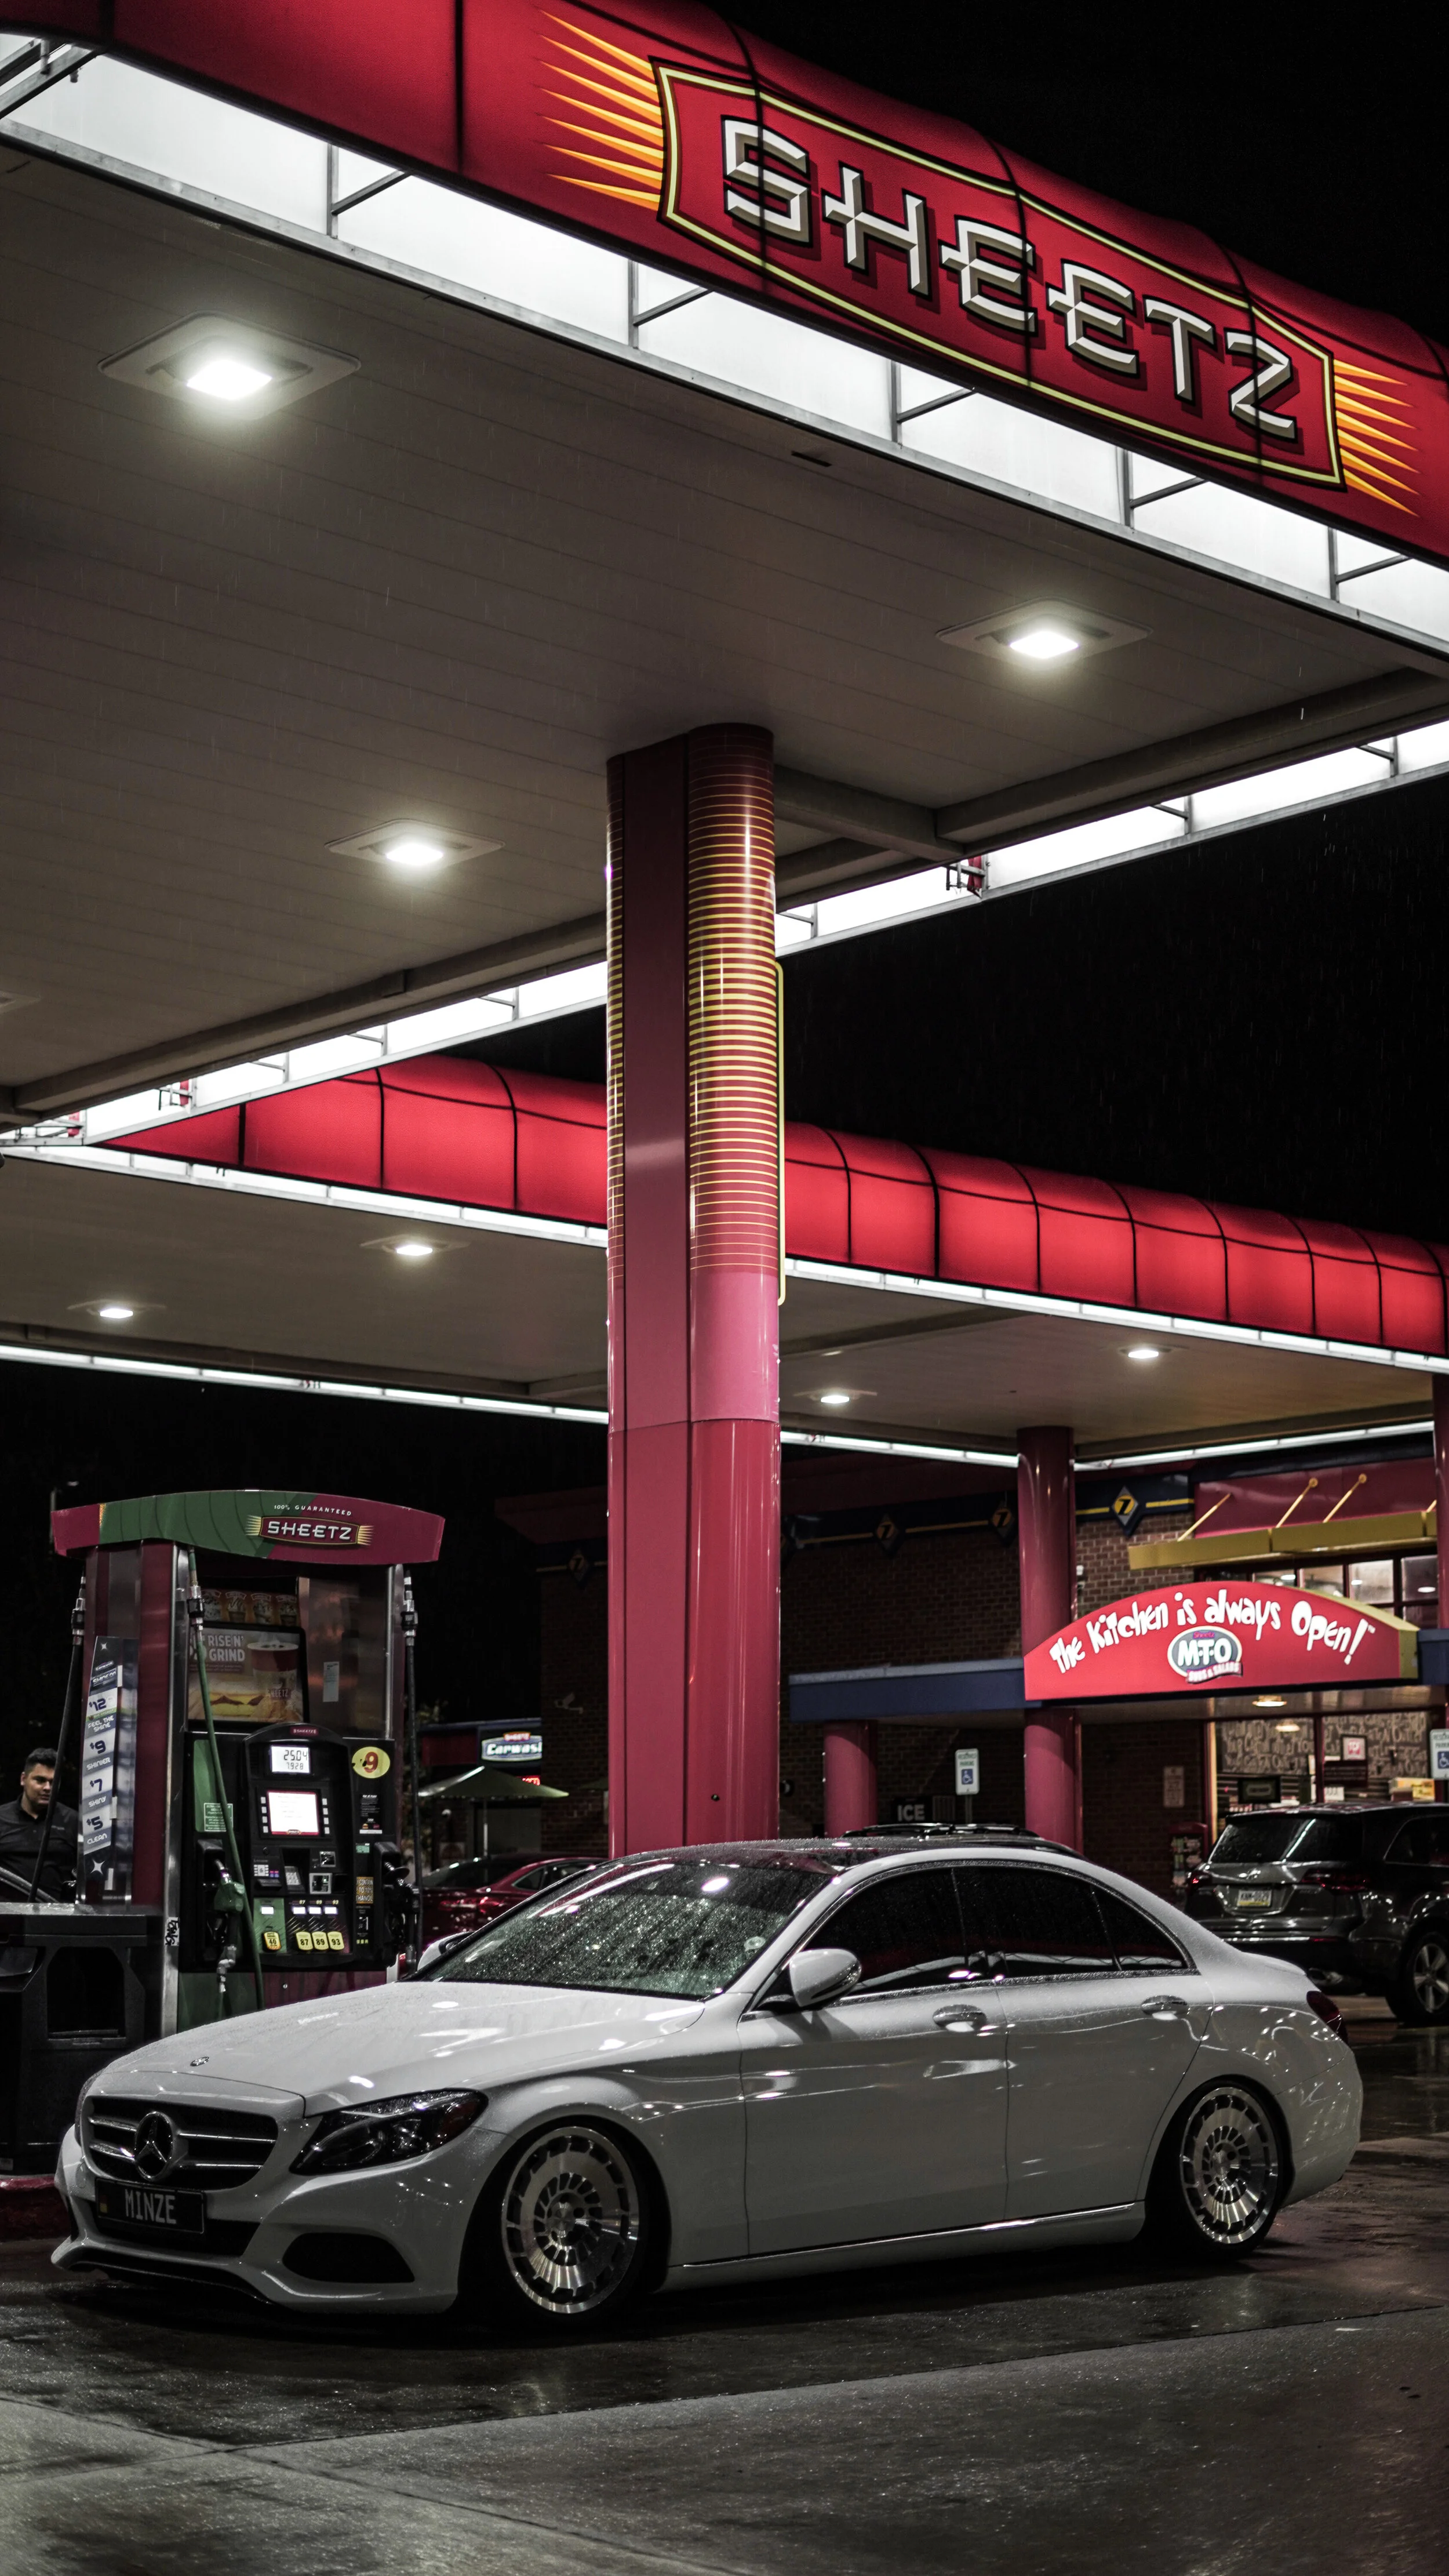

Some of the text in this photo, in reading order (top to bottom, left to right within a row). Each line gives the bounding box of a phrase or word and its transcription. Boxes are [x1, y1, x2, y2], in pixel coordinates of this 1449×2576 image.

[722, 115, 1297, 441] SHEETZ
[295, 1505, 352, 1516] GUARANTEED
[267, 1521, 352, 1540] SHEETZ
[1050, 1636, 1086, 1674] The
[1086, 1601, 1168, 1654] Kitchen
[1174, 1592, 1196, 1626] is
[1204, 1589, 1280, 1640] always
[207, 1635, 231, 1647] RISE
[209, 1649, 245, 1662] GRIND
[89, 1698, 107, 1711] $12
[88, 1720, 102, 1728] FEEL
[93, 1722, 111, 1732] SHINE
[90, 1740, 106, 1754] $9
[86, 1757, 111, 1770] SHINIER
[90, 1778, 103, 1792] $7
[88, 1796, 106, 1807] SHINY
[898, 1804, 925, 1822] ICE
[86, 1816, 103, 1830] $5
[87, 1833, 107, 1844] CLEAN
[125, 2189, 176, 2225] MINZE
